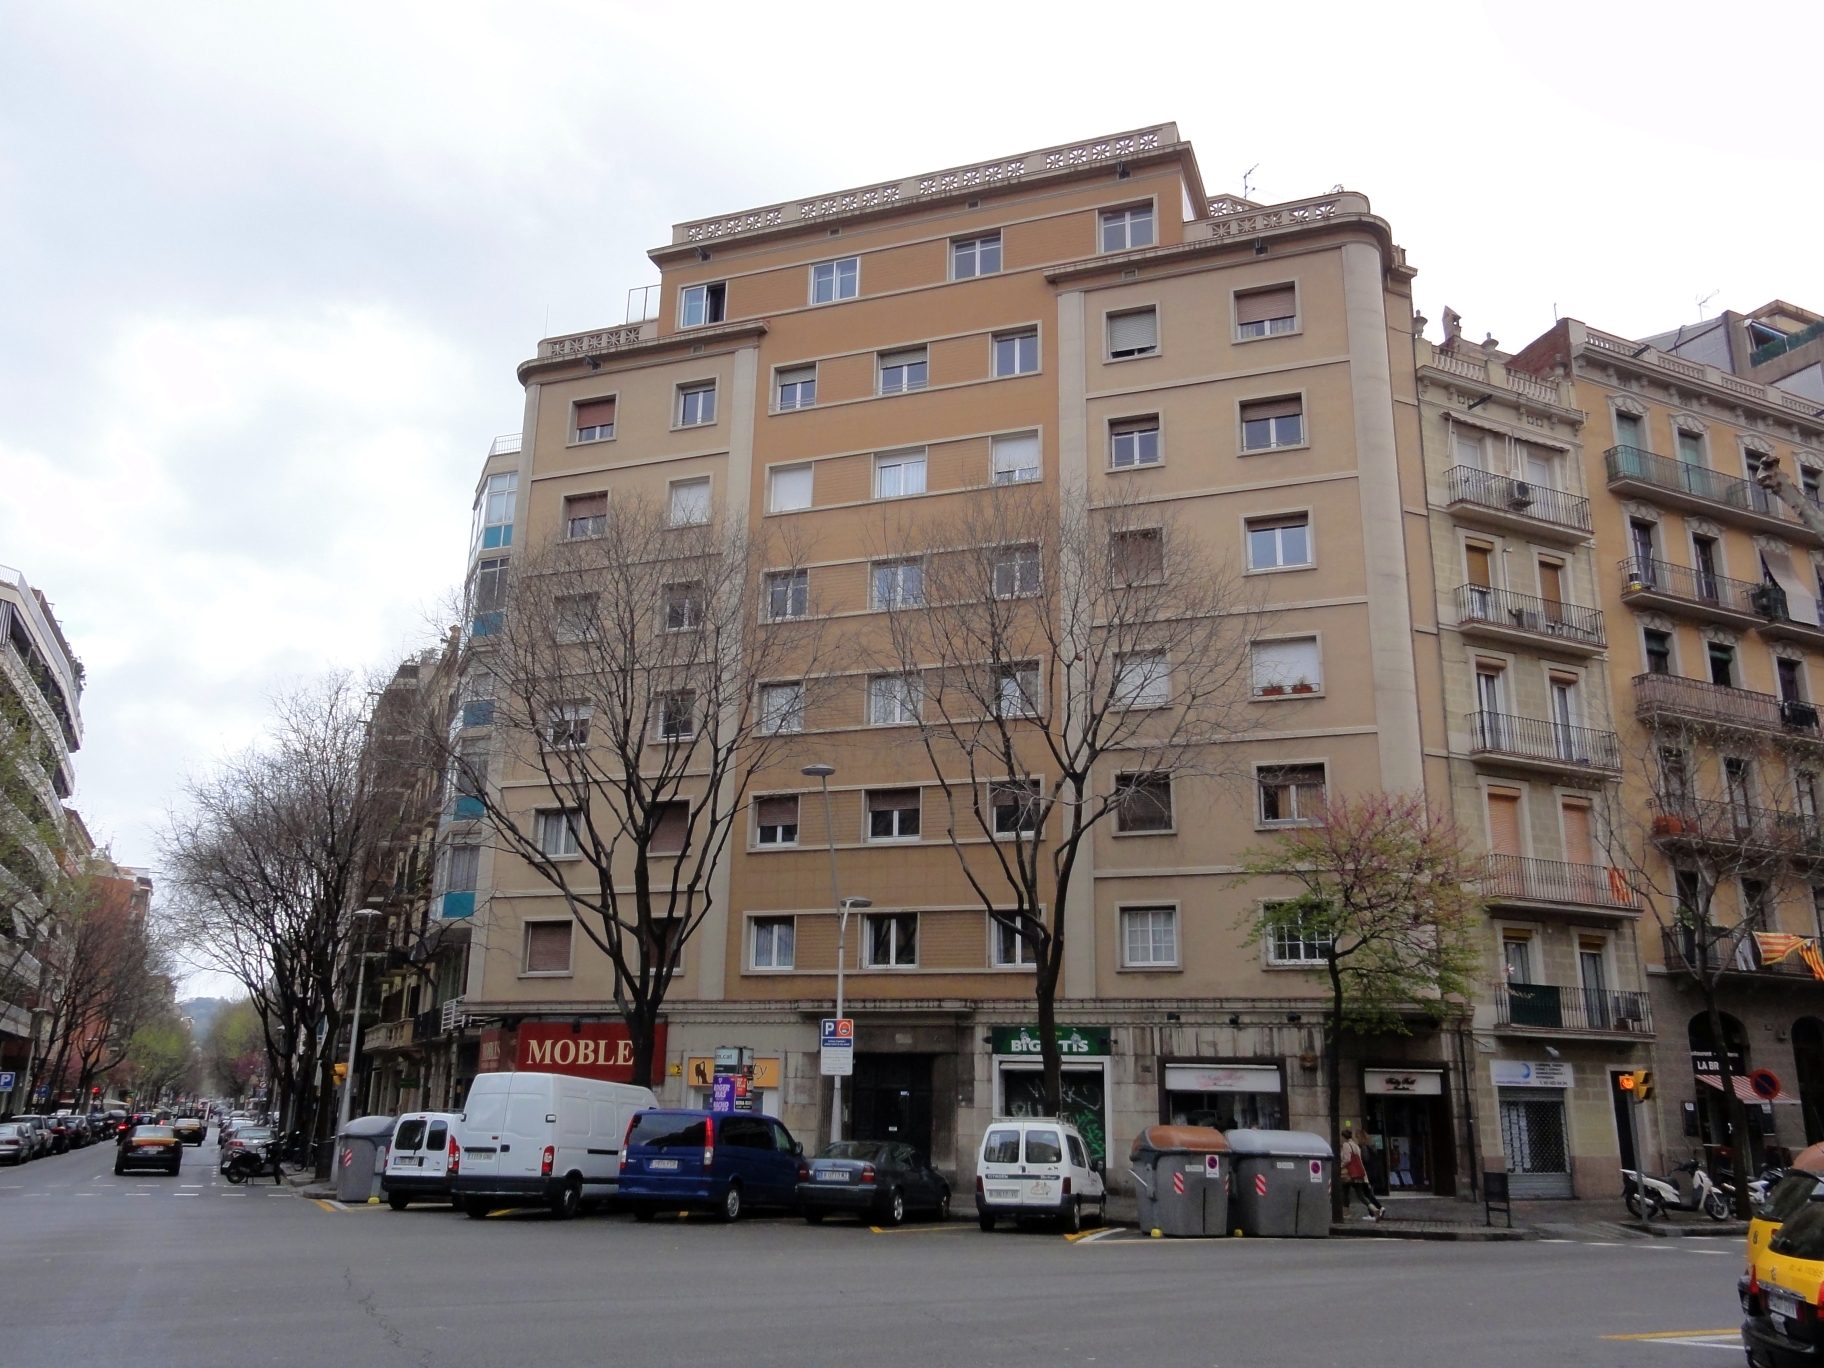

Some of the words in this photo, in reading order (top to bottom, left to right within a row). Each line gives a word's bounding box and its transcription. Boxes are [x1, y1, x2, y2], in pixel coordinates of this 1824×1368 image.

[825, 1022, 835, 1035] P
[1011, 1040, 1089, 1052] BIGTIS
[1697, 1061, 1708, 1070] LA
[1, 1074, 12, 1086] P
